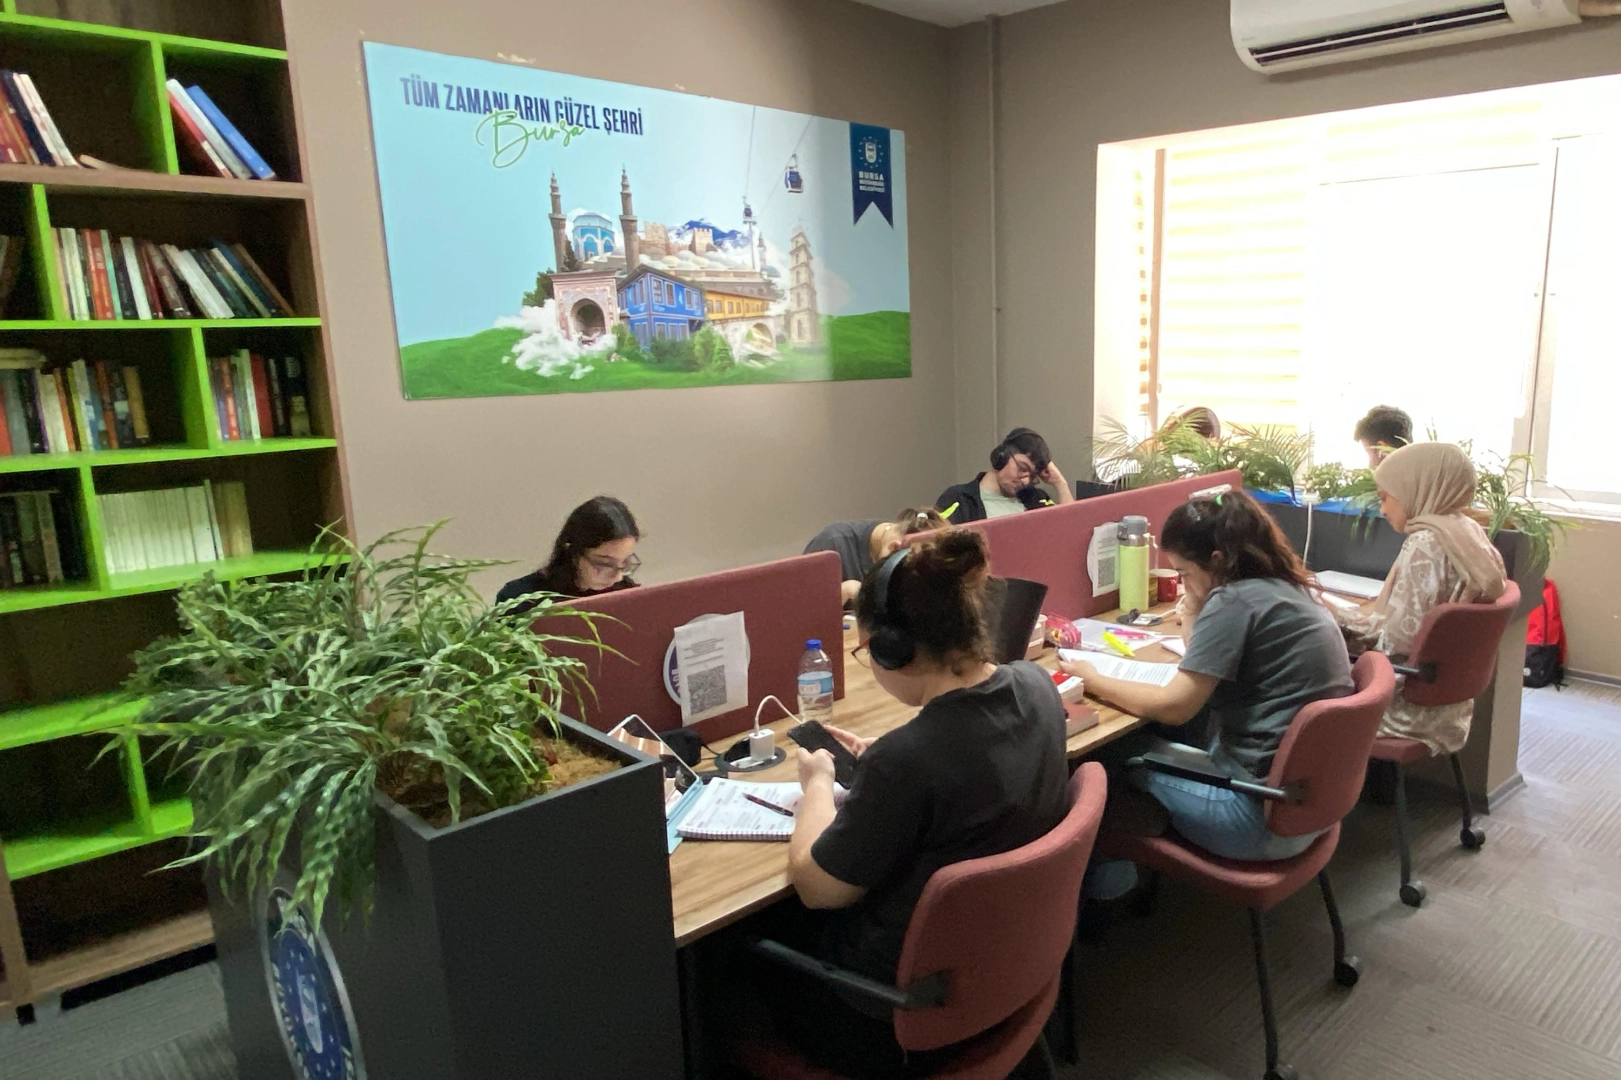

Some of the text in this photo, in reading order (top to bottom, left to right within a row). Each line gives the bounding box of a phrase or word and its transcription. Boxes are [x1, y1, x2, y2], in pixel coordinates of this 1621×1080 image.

[400, 74, 643, 136] TÜM ZAMANLARIN GÜZEL ŞEHRİ
[475, 109, 585, 169] Bursa
